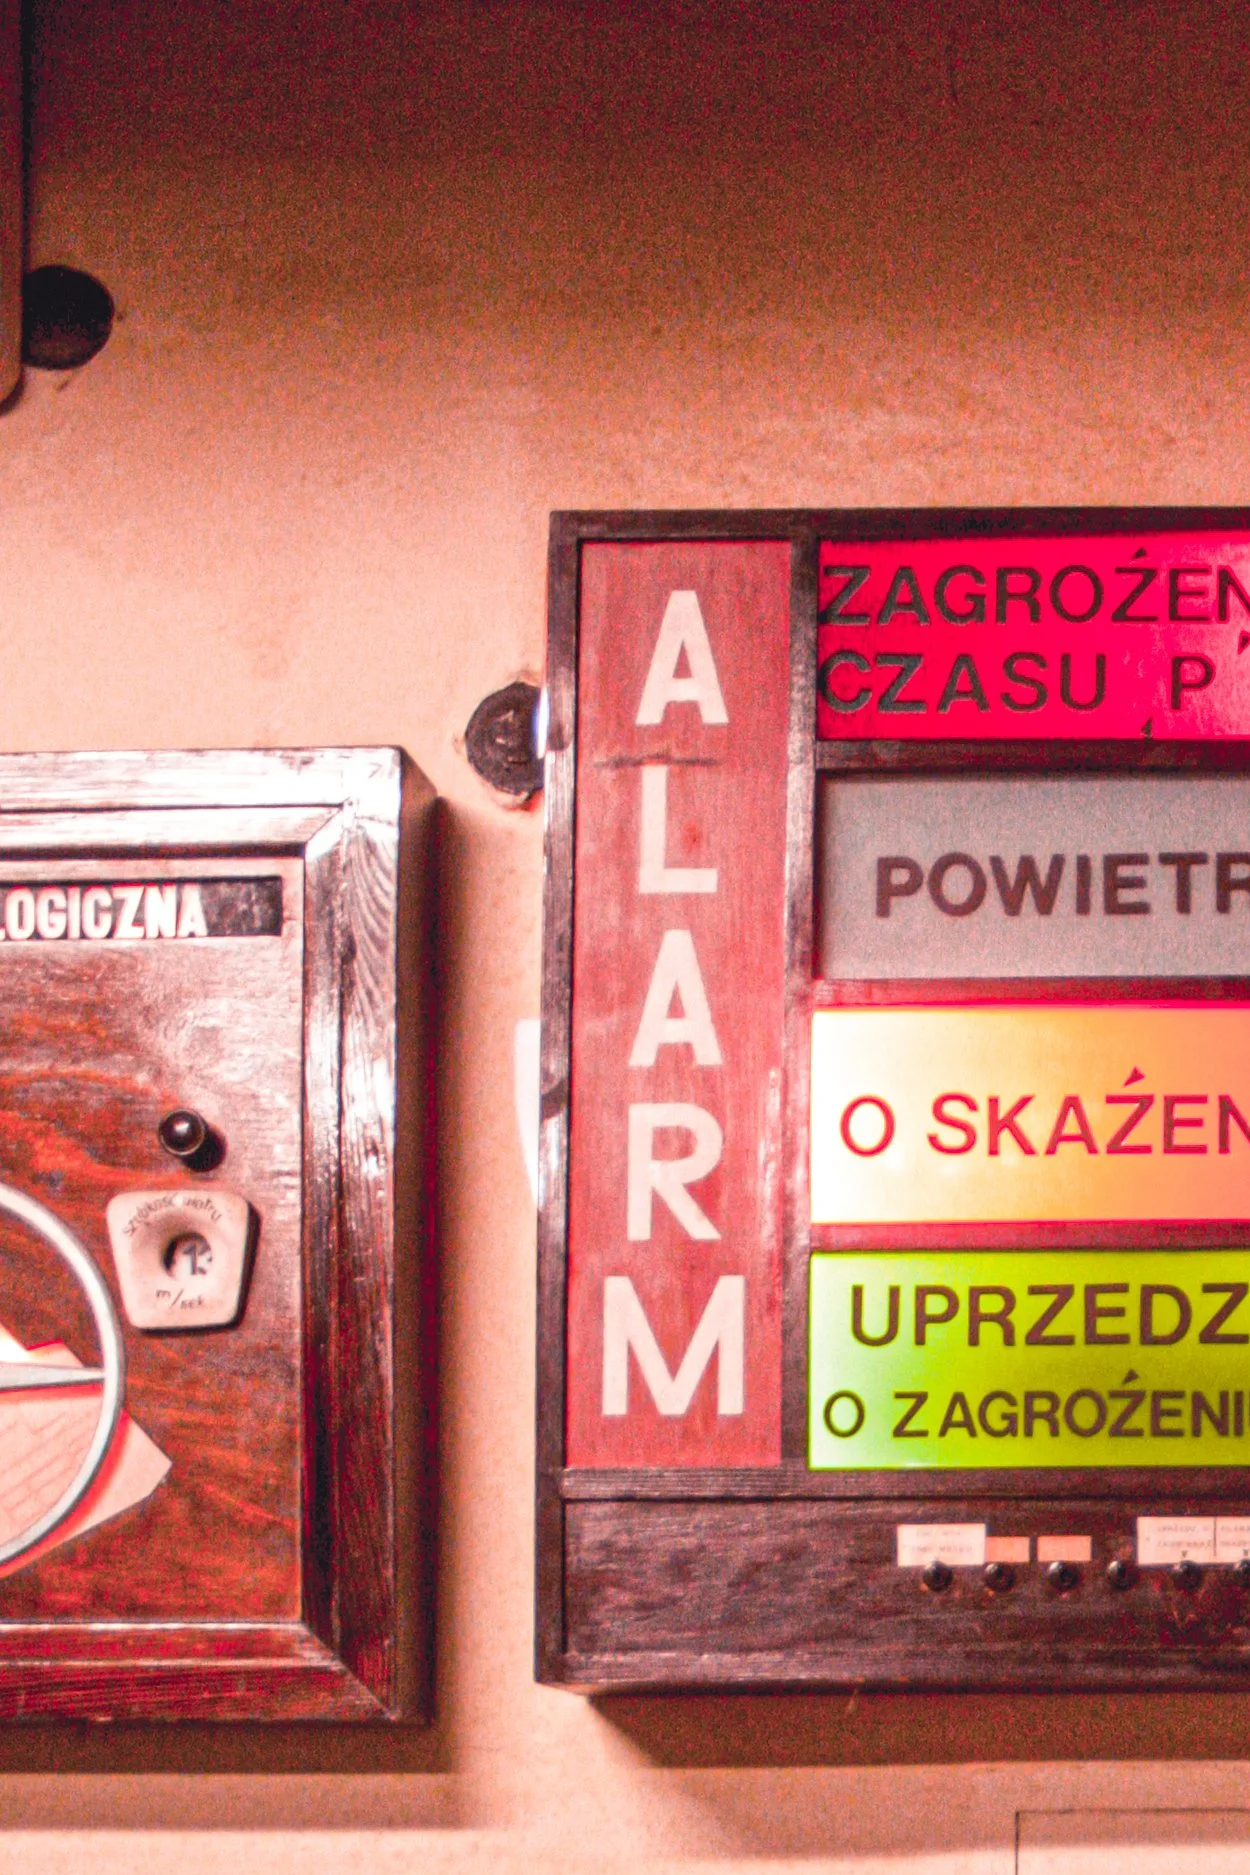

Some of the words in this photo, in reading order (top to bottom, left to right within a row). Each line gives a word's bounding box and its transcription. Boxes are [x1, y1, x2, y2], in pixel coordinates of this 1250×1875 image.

[819, 648, 1107, 714] CZASU
[1169, 655, 1217, 711] P
[602, 589, 745, 1416] ALARM
[839, 1093, 896, 1158] O
[822, 1388, 866, 1439] O
